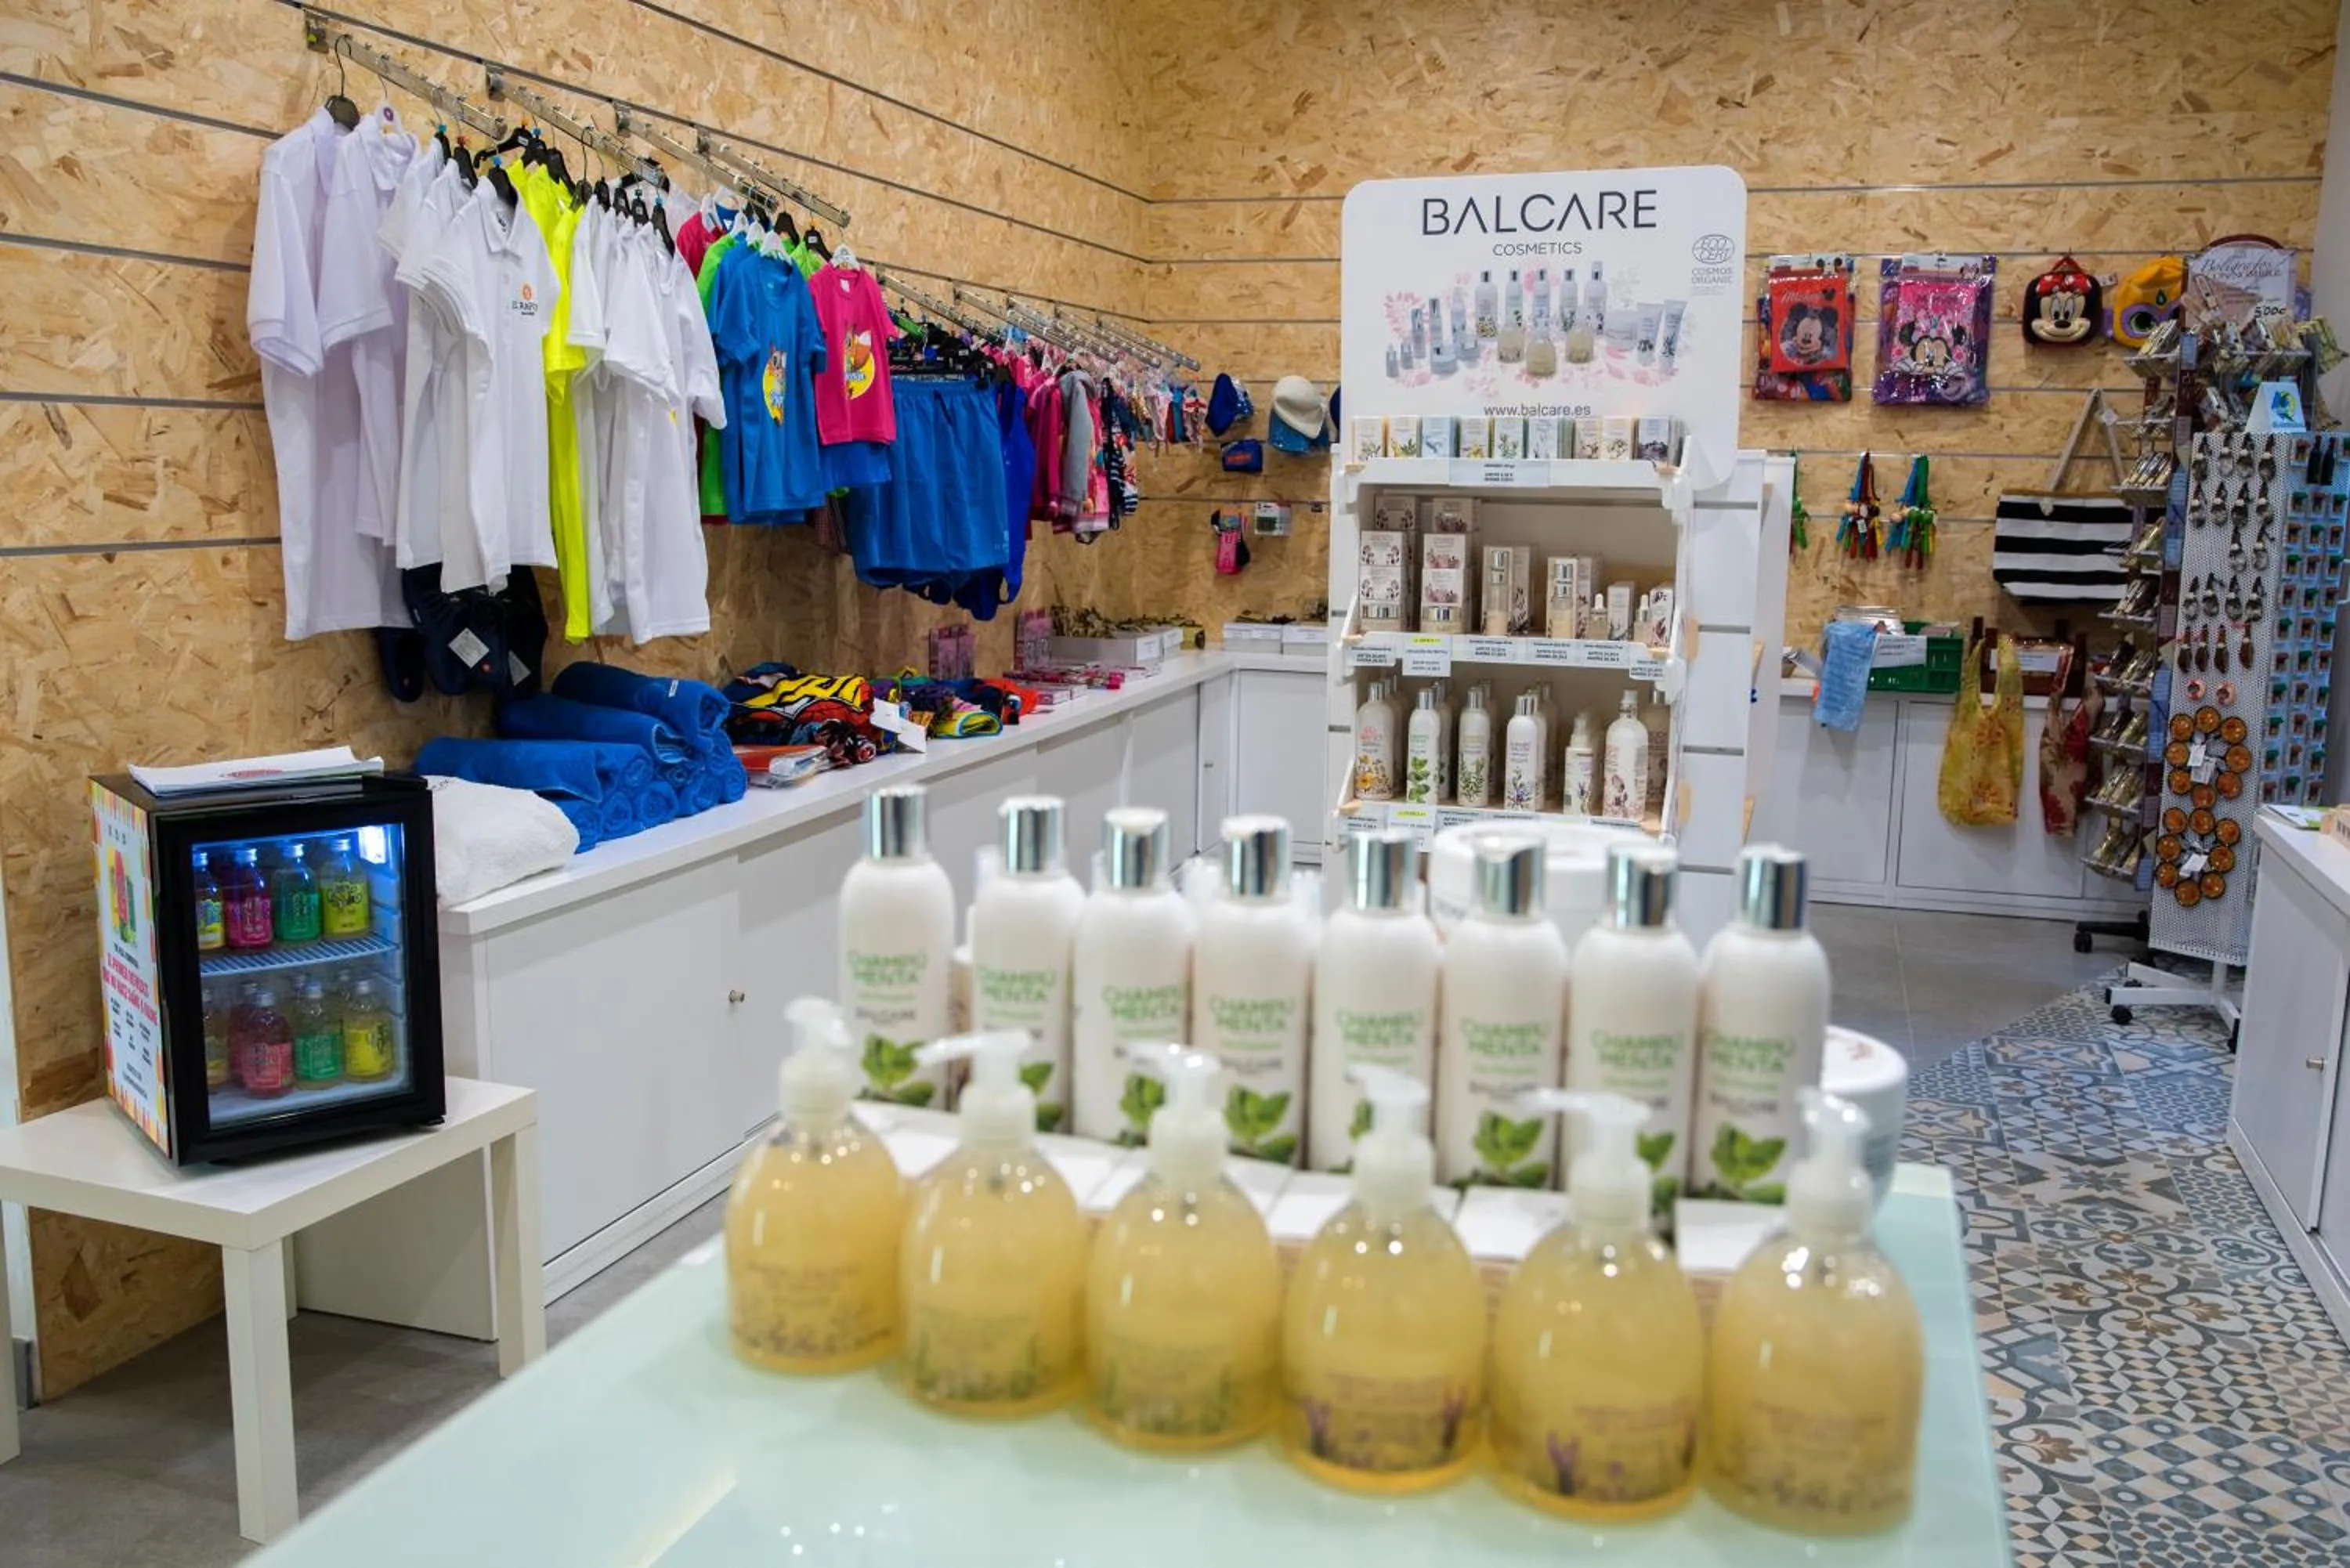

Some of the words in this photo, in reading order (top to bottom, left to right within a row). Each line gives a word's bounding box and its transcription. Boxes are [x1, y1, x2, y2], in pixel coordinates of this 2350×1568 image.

[1422, 190, 1658, 235] BALCARE
[1492, 241, 1582, 256] COSMETICS
[1483, 403, 1592, 417] www.balcare.es
